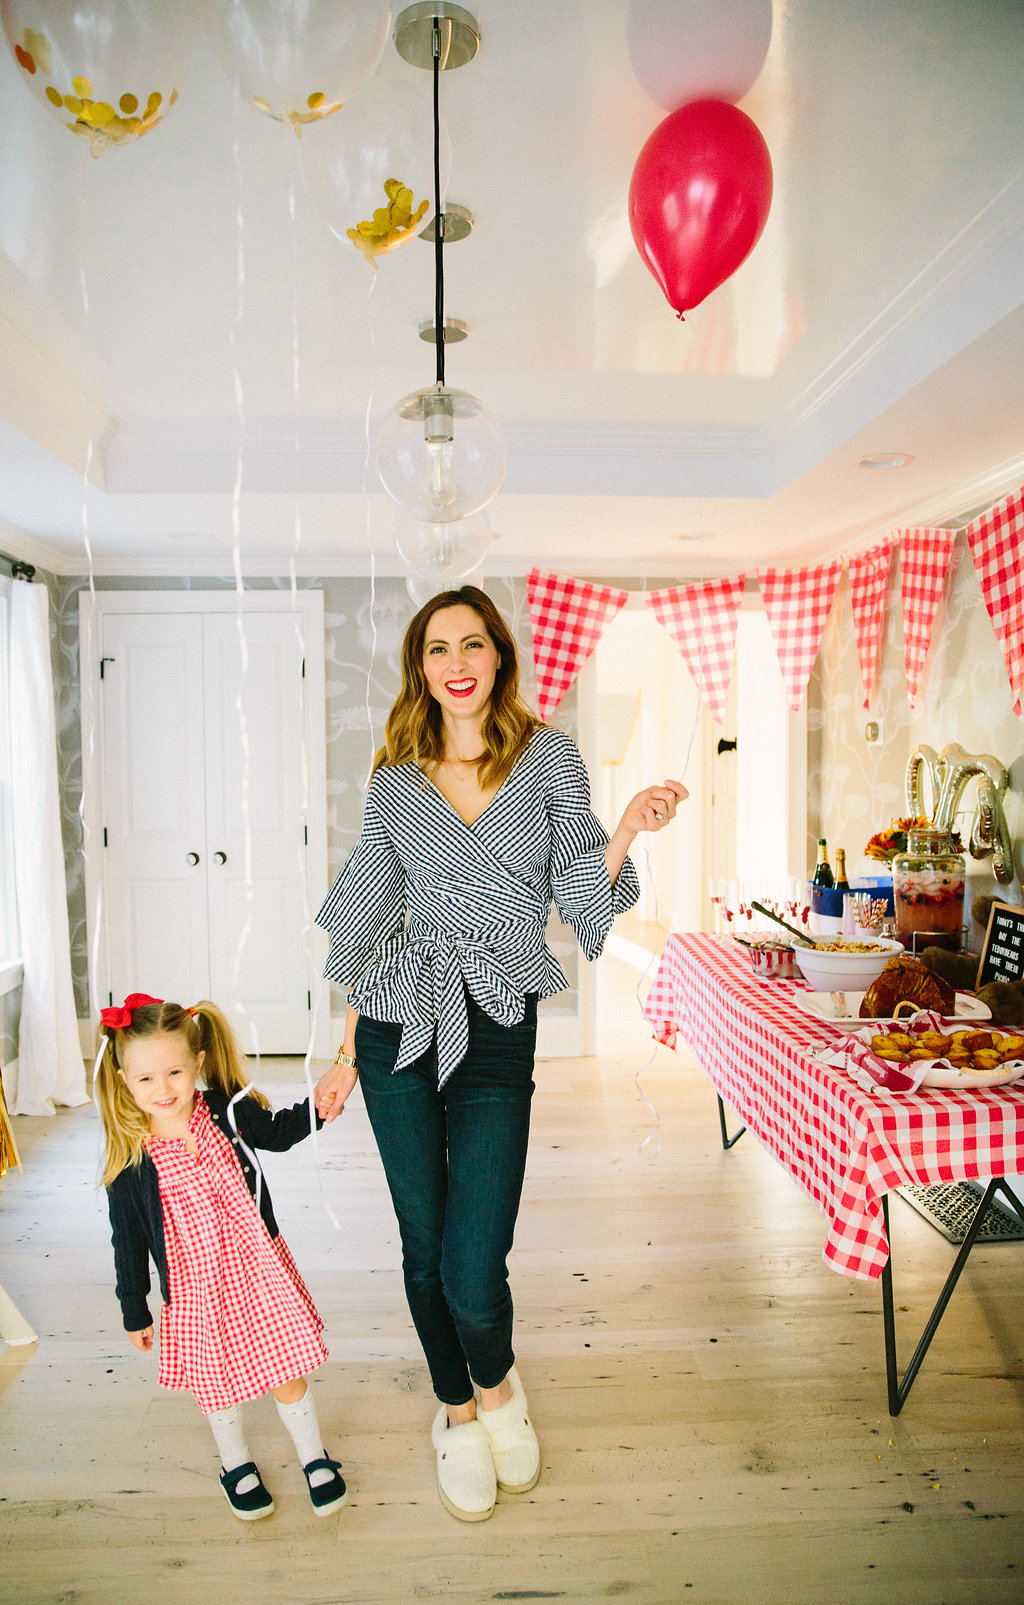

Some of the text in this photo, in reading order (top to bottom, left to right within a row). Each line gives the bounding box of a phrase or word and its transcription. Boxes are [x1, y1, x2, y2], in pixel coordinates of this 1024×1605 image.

[997, 916, 1013, 928] TODAY'S
[998, 931, 1021, 946] DAY THE
[992, 943, 1019, 961] TEDDYBEARS
[989, 955, 1019, 974] HAVE THEIR
